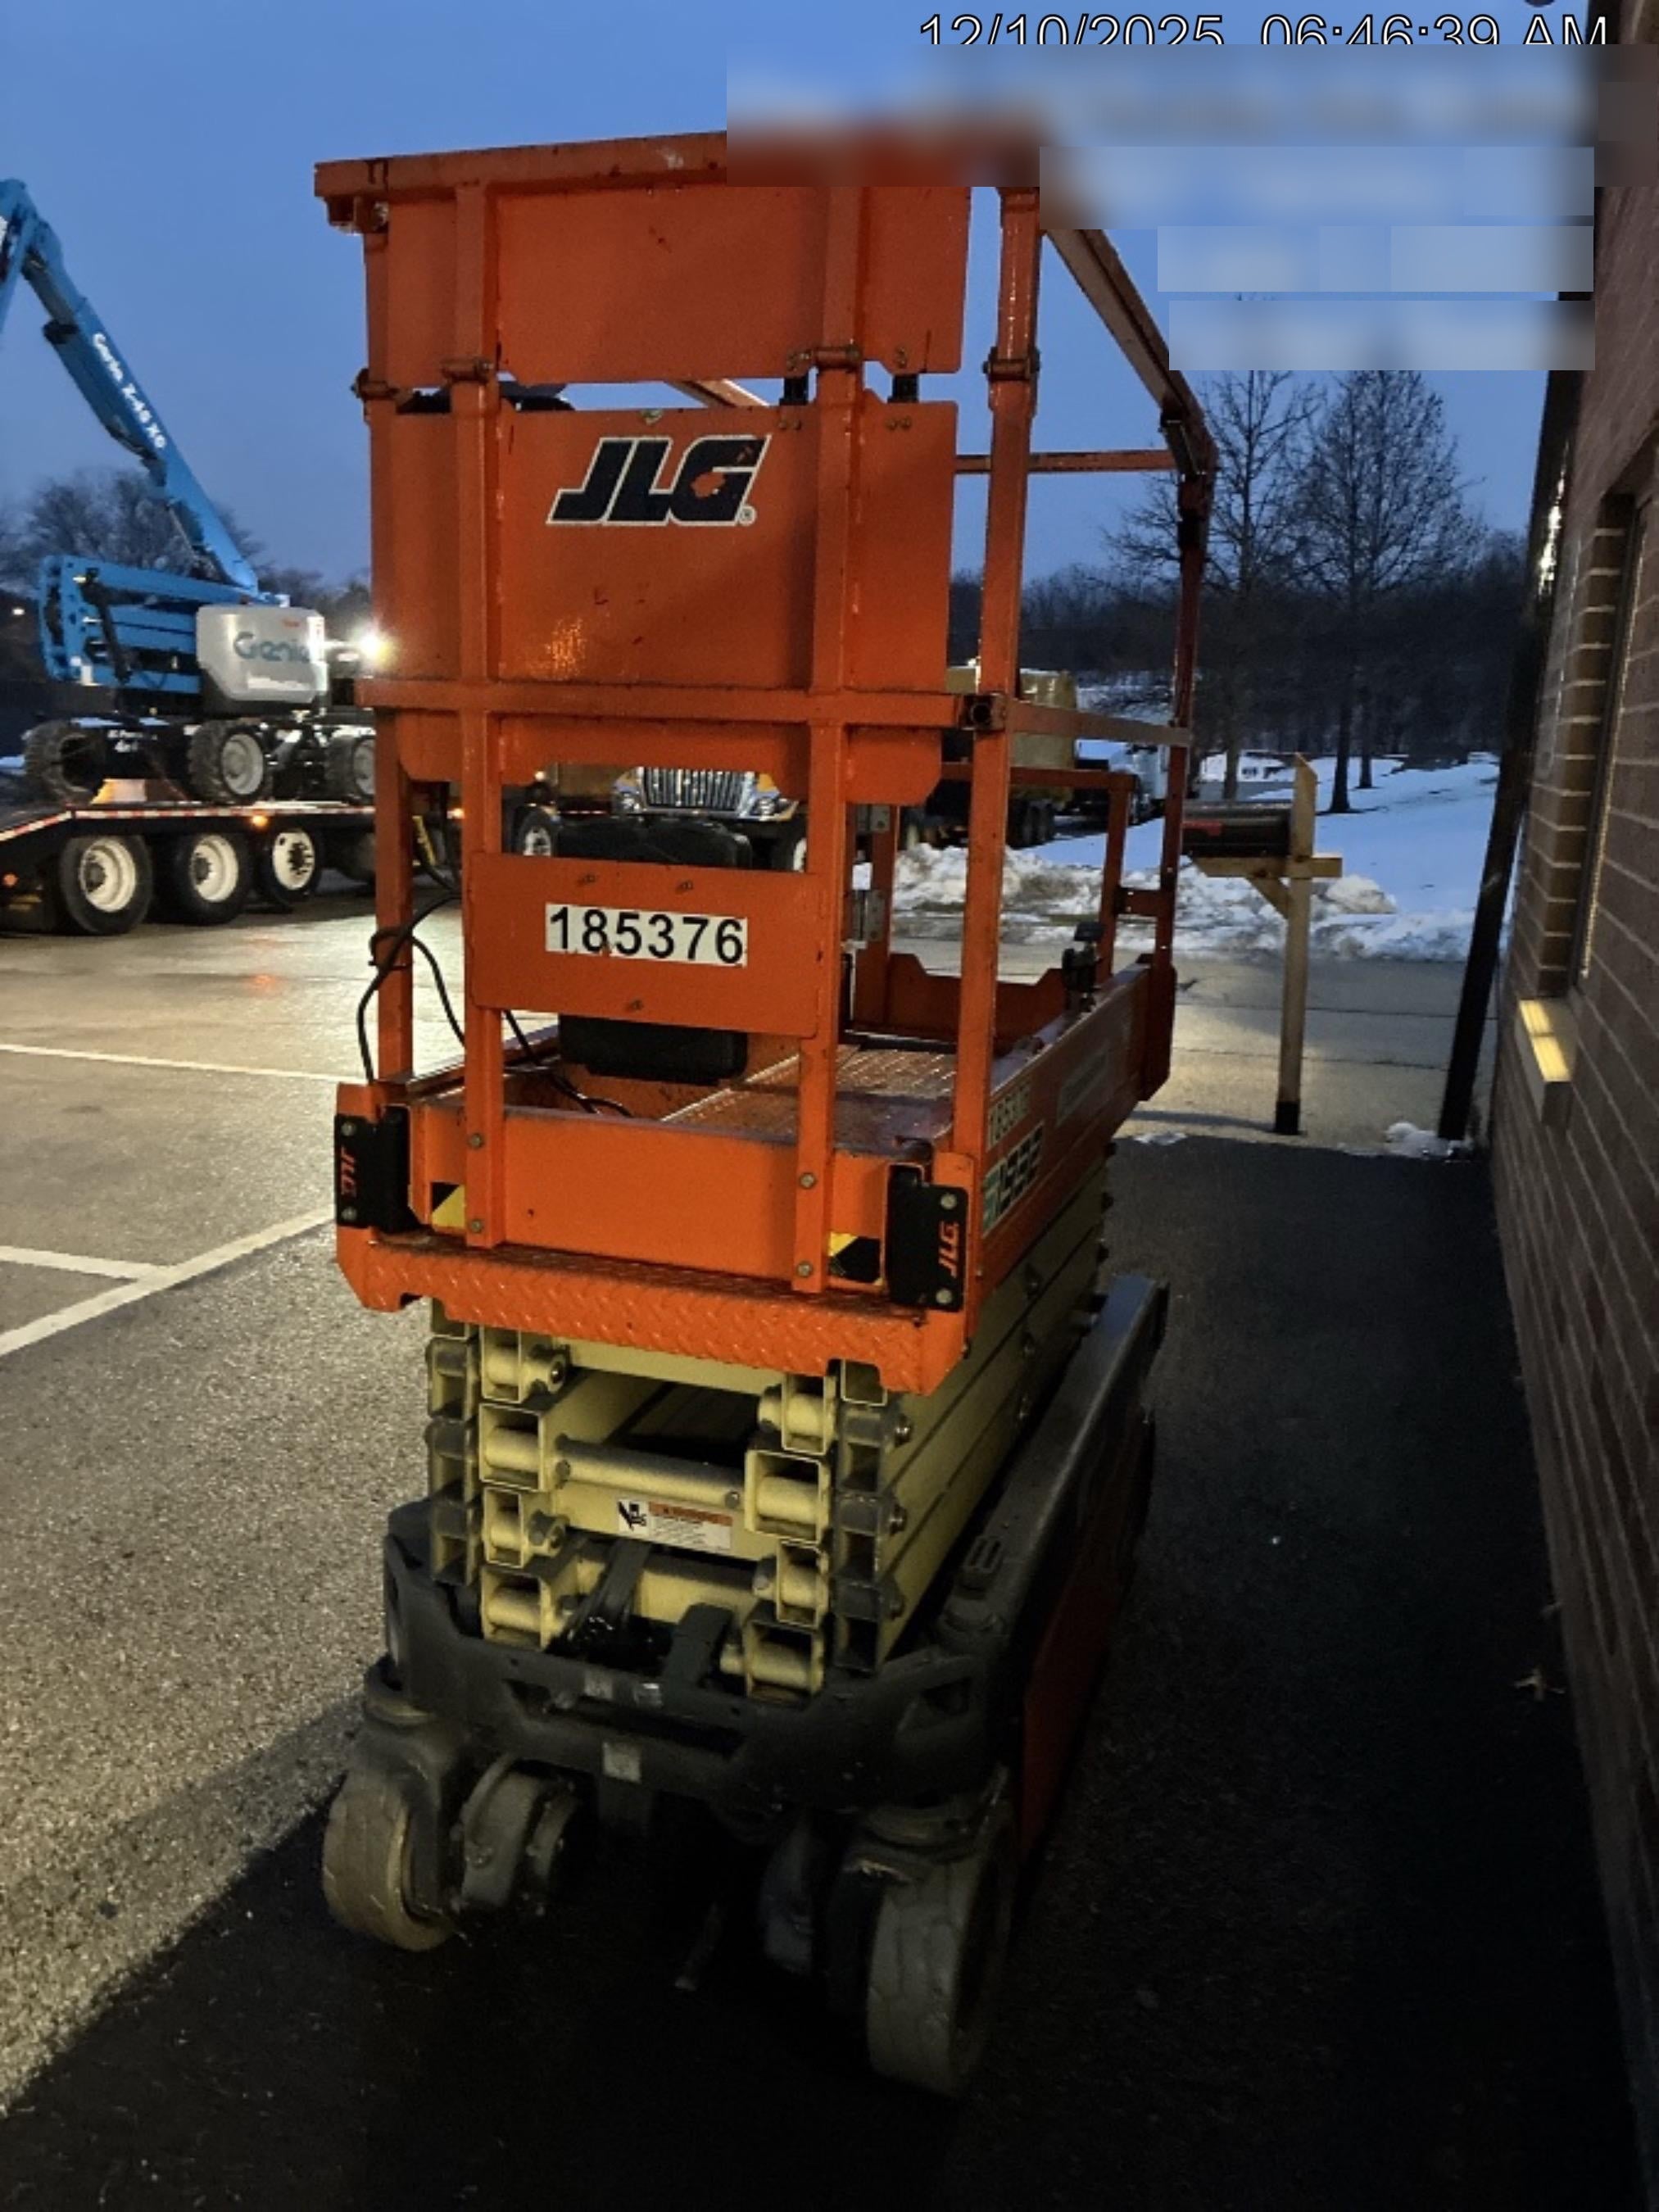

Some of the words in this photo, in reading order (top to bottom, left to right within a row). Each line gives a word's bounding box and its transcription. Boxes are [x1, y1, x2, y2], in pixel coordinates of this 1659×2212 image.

[546, 433, 772, 527] JLG
[233, 630, 311, 664] Genie
[550, 905, 743, 964] 185376
[938, 1221, 959, 1280] JLG
